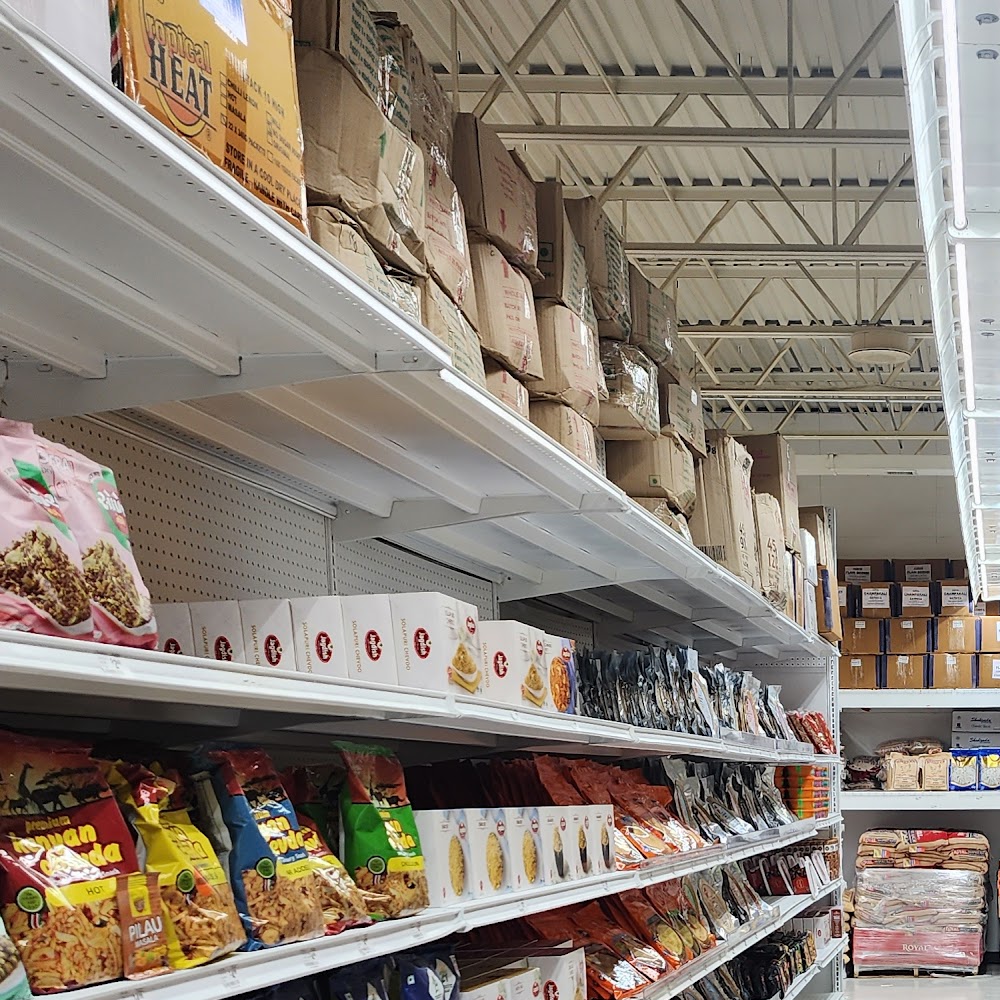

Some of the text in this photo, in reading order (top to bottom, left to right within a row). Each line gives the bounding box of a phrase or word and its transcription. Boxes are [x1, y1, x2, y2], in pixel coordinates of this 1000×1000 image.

[149, 38, 213, 119] HEAT
[224, 156, 249, 185] FRAGILE
[225, 141, 246, 165] STORE
[246, 158, 254, 170] IN
[260, 167, 275, 188] COOL
[275, 178, 288, 196] DRY
[287, 189, 302, 206] PLAC
[318, 636, 331, 661] Jagdish
[86, 885, 107, 896] HOT
[128, 916, 163, 942] PILAU
[135, 934, 160, 949] MASALA
